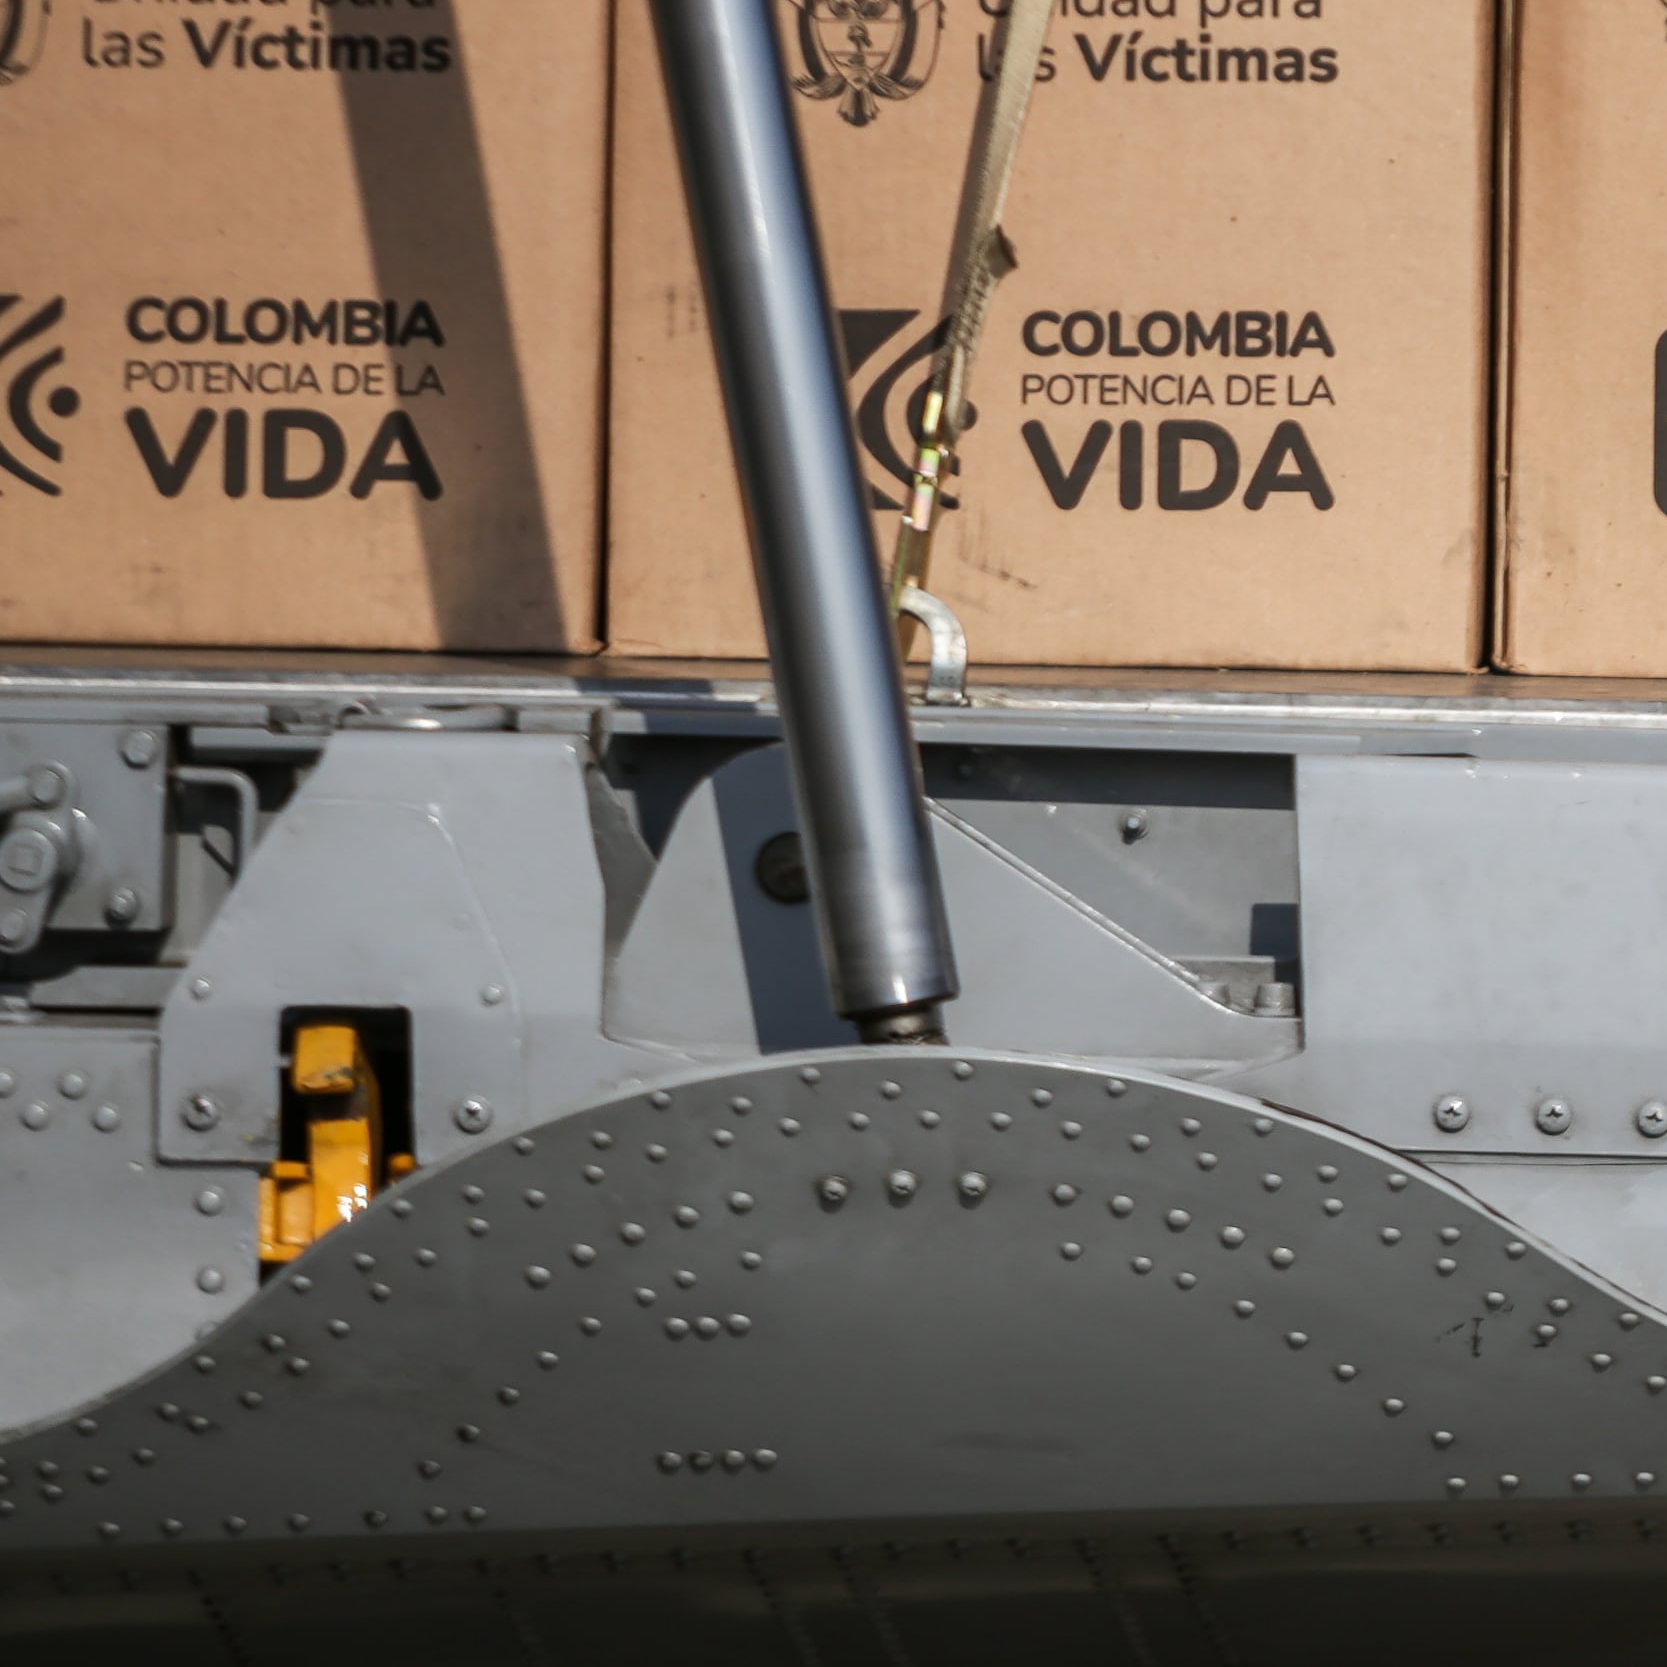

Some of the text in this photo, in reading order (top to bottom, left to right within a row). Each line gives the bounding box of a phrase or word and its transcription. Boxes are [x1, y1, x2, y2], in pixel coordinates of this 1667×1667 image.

[82, 17, 452, 74] las Víctimas
[977, 29, 1340, 85] ls Víctimas
[125, 295, 447, 347] COLOMBIA
[1020, 309, 1337, 360] COLOMBIA
[123, 359, 447, 397] POTENCIA DE LA
[1020, 373, 1337, 407] POTENCIA DE LA
[123, 405, 444, 502] VIDA
[1020, 418, 1336, 513] VIDA
